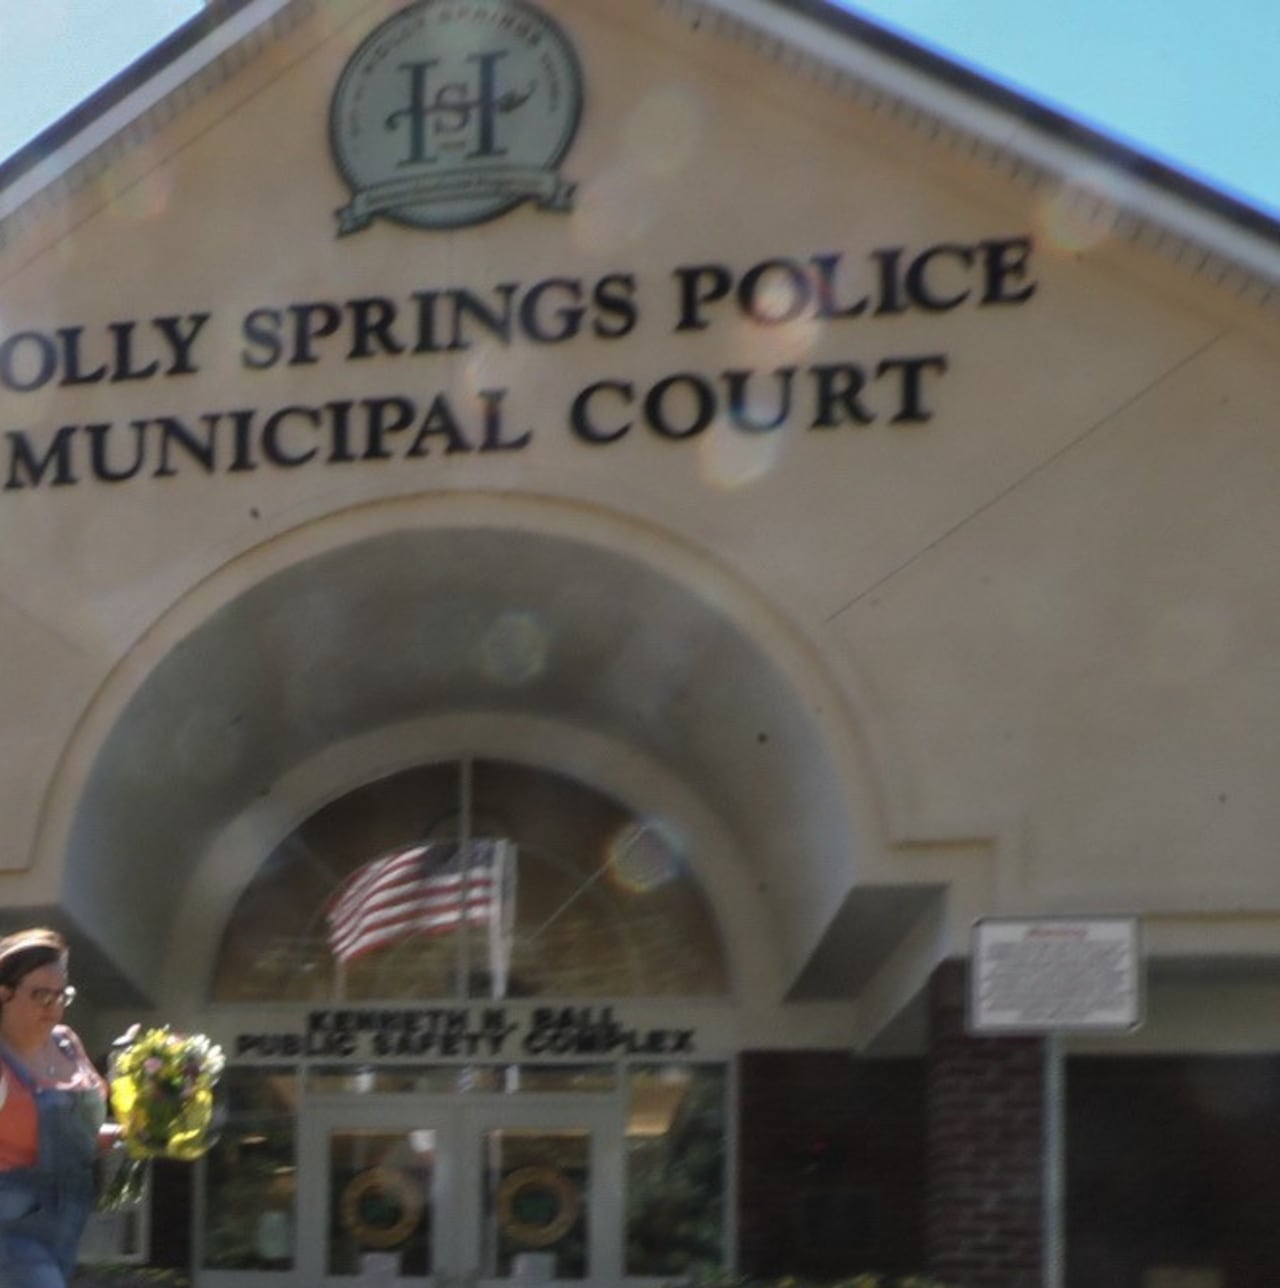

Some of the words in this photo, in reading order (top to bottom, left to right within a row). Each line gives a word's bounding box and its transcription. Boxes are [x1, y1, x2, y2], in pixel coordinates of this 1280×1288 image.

[240, 272, 639, 372] SPRINGS
[672, 236, 1037, 331] POLICE
[1, 388, 532, 491] MUNICIPAL
[568, 354, 949, 446] COURT
[236, 1031, 358, 1058] PUBLIC
[371, 1030, 509, 1057] SAFETY
[521, 1027, 696, 1055] COMPLEX
[308, 1008, 470, 1032] KENNETH
